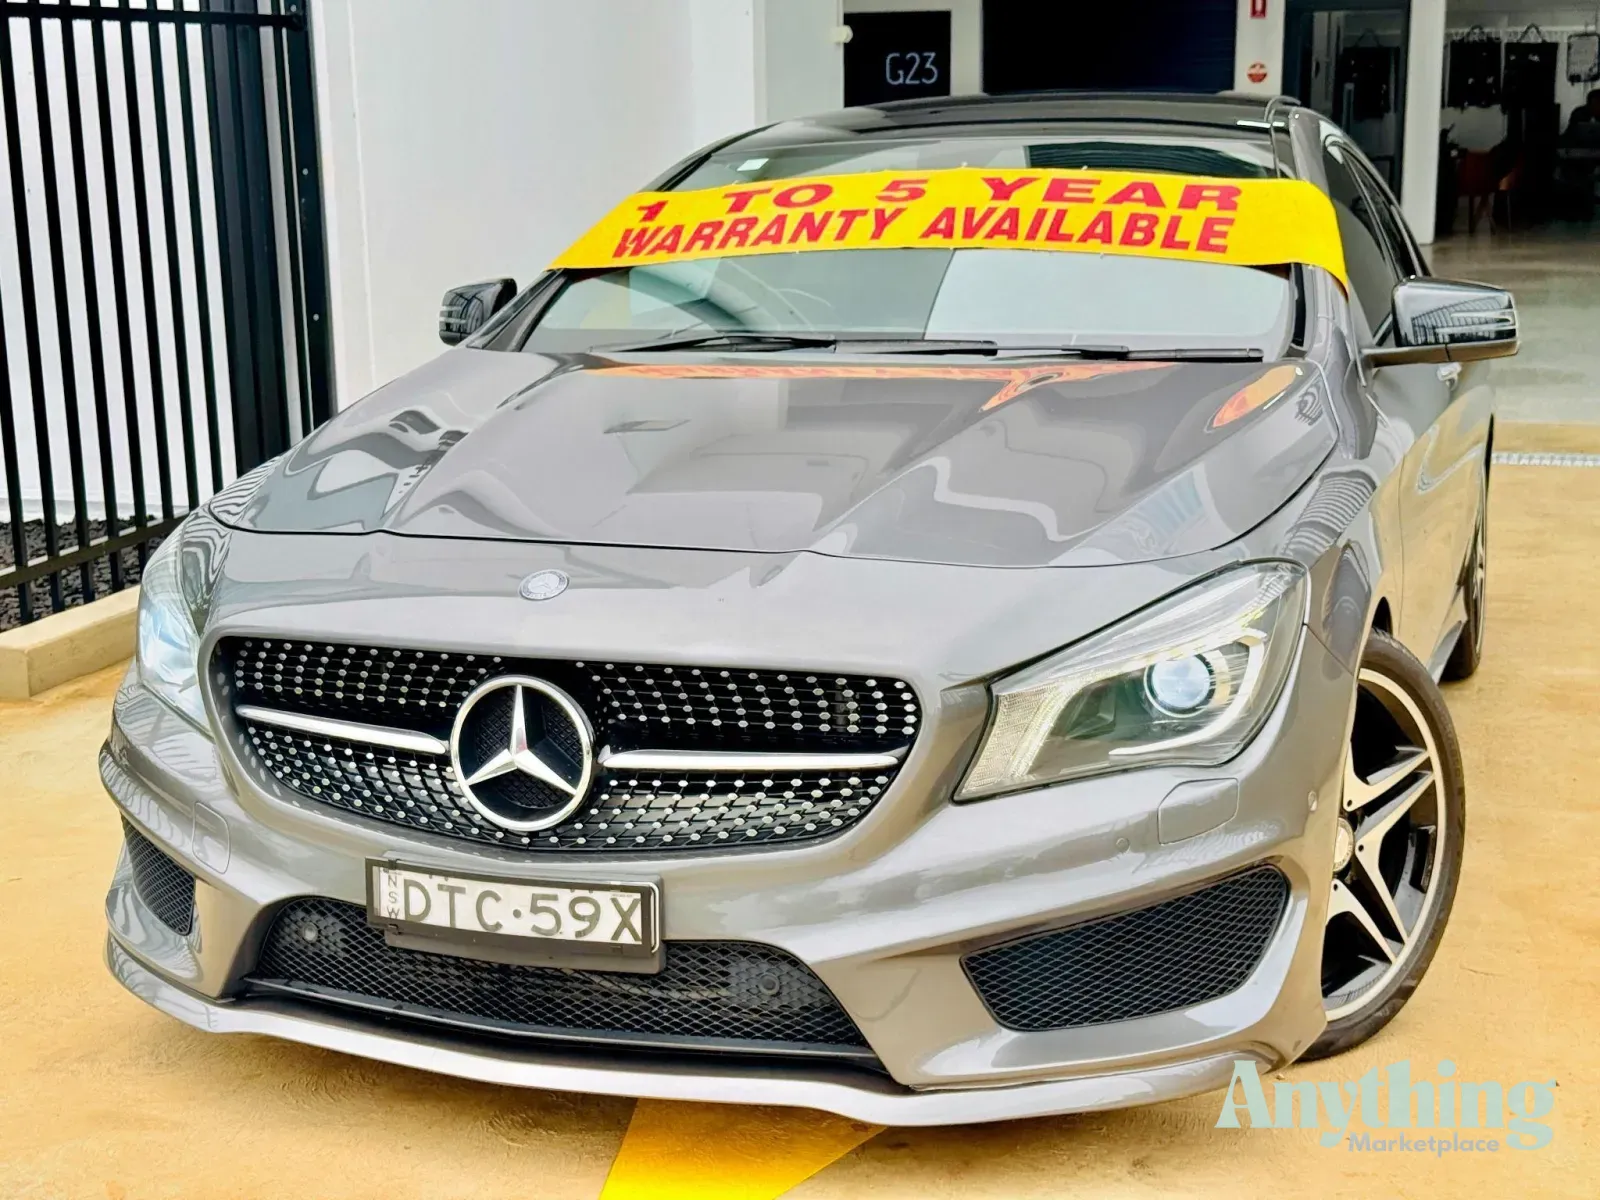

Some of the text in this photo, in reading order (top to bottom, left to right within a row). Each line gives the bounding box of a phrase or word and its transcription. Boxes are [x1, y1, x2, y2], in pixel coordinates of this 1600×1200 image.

[885, 52, 939, 85] G23
[637, 176, 1243, 223] 1 TO 5 YEAR
[612, 206, 1236, 259] WARRANTY AVAILABLE
